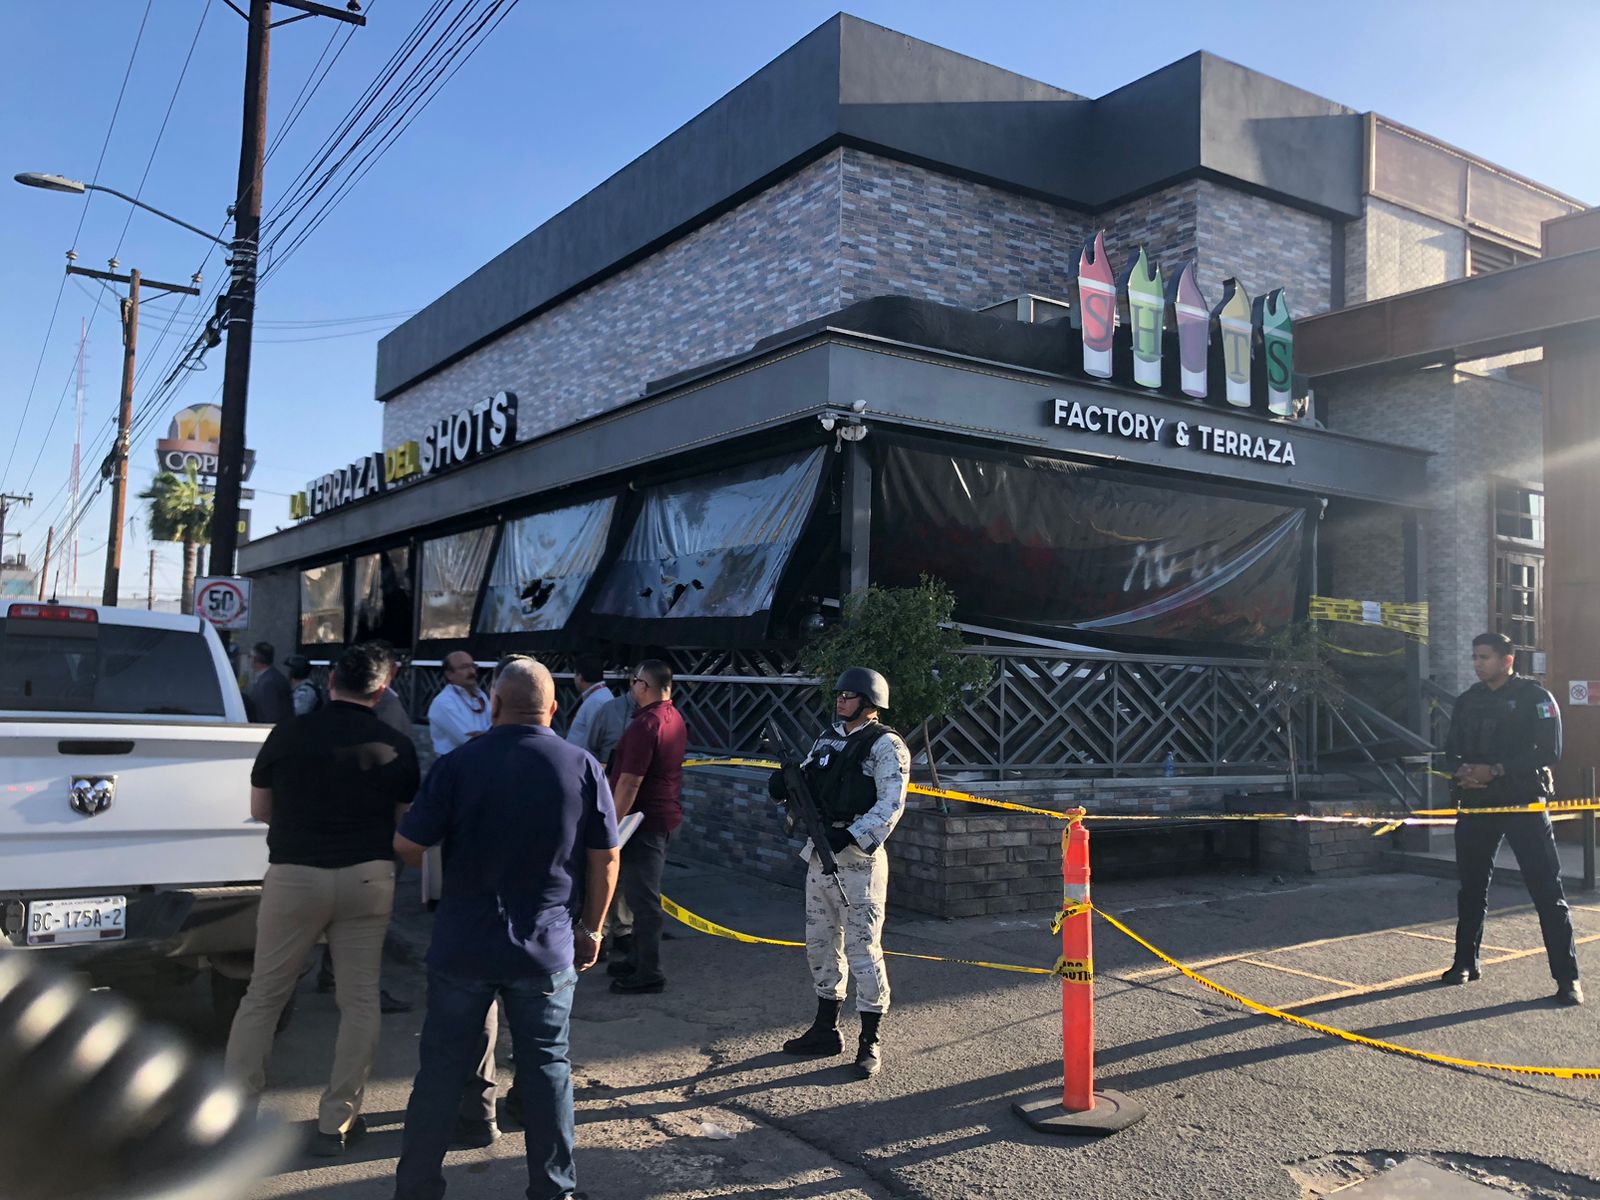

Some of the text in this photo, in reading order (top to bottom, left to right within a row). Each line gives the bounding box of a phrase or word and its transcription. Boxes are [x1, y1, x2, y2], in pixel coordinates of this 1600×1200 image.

[1054, 399, 1296, 466] FACTORY & TERRAZA
[289, 391, 516, 520] LA TERRAZA DEL SHOTS
[209, 590, 234, 611] 50
[33, 909, 122, 931] BC-175A-2
